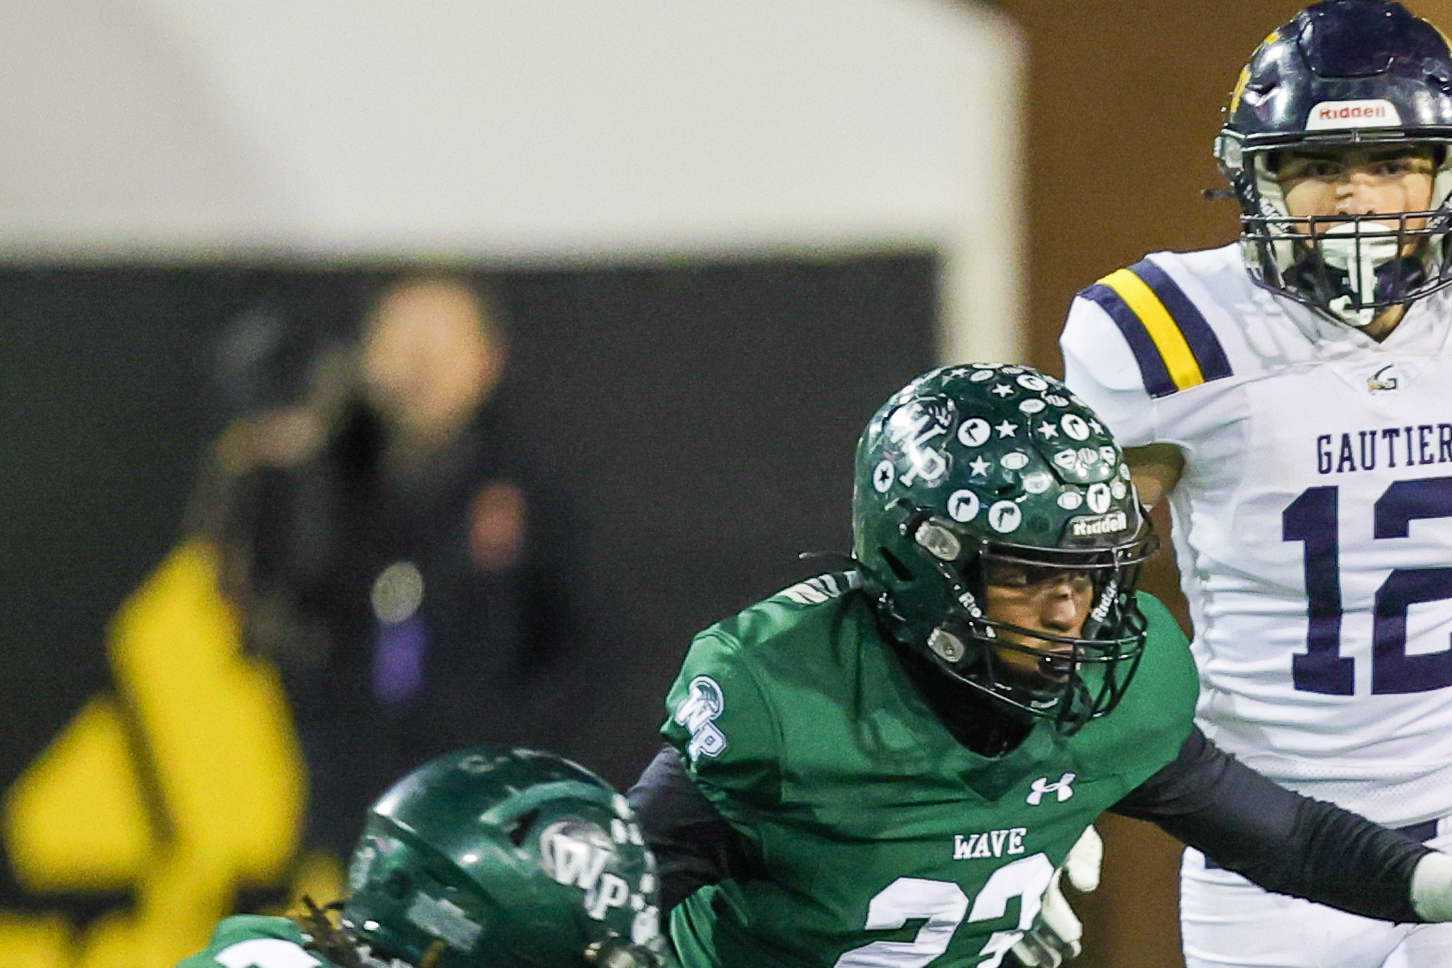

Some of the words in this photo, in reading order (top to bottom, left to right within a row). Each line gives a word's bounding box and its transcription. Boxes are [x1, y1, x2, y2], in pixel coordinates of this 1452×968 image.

[1319, 106, 1386, 120] Riddell
[1073, 511, 1127, 536] Riddell
[952, 827, 1027, 860] WAVE
